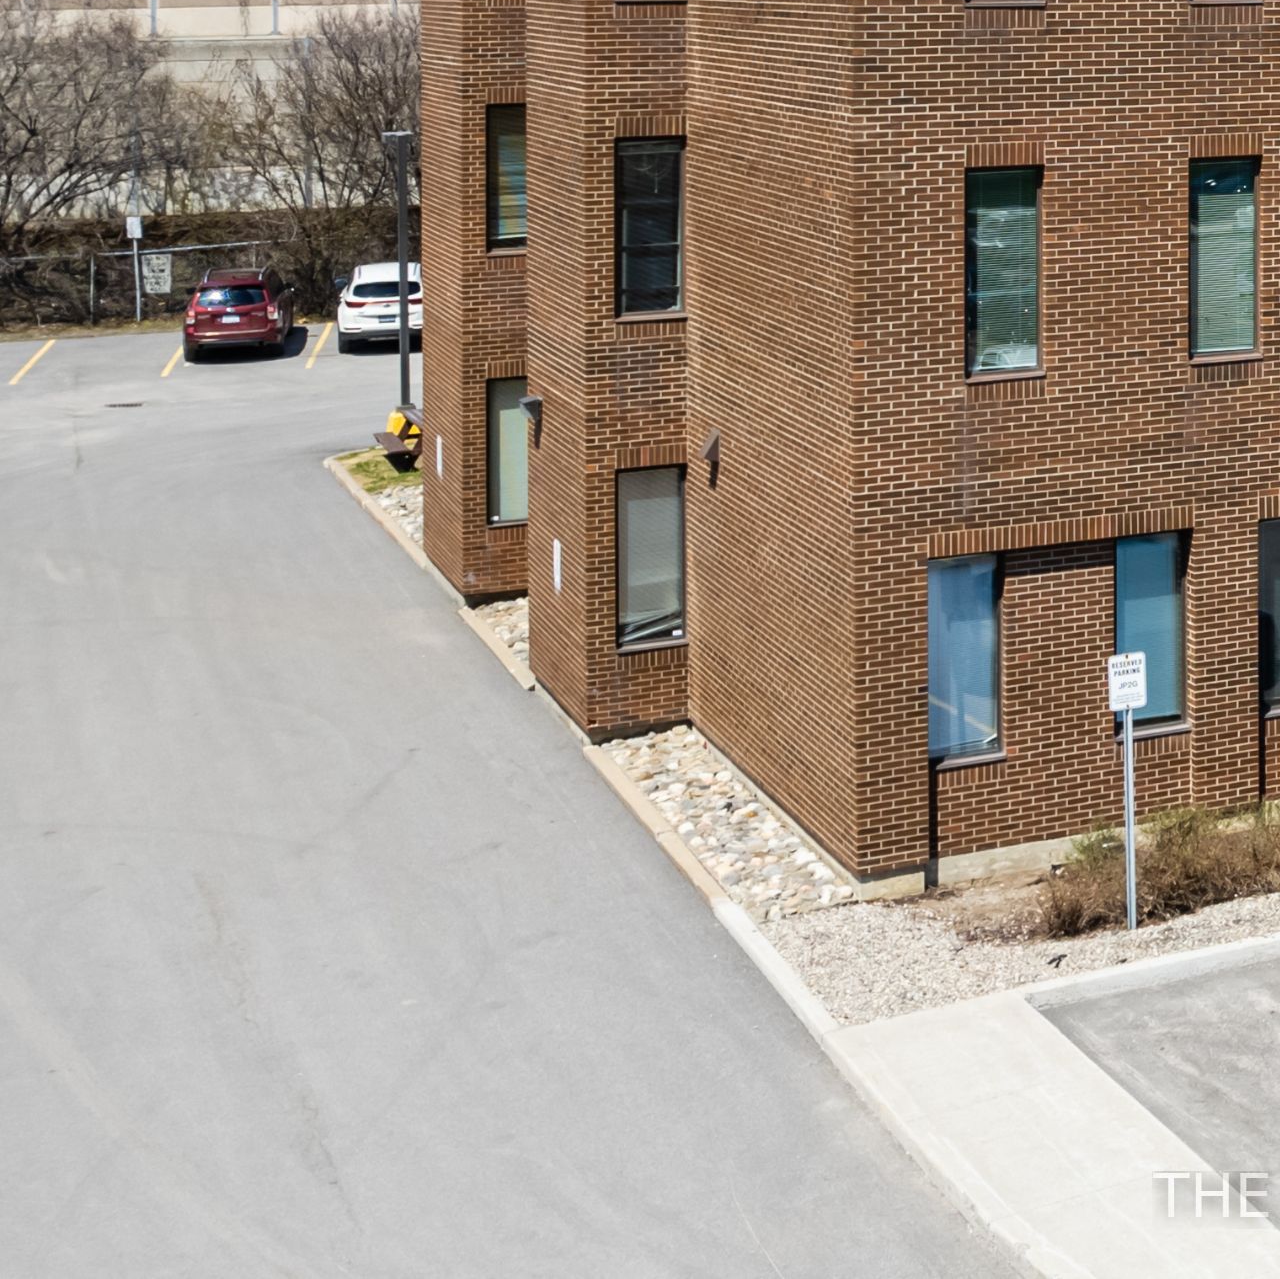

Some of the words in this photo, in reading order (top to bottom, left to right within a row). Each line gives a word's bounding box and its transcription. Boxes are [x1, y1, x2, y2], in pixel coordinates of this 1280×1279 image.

[1111, 659, 1142, 670] RESERVED
[1113, 667, 1141, 677] PARKING
[1119, 680, 1139, 690] JP2G
